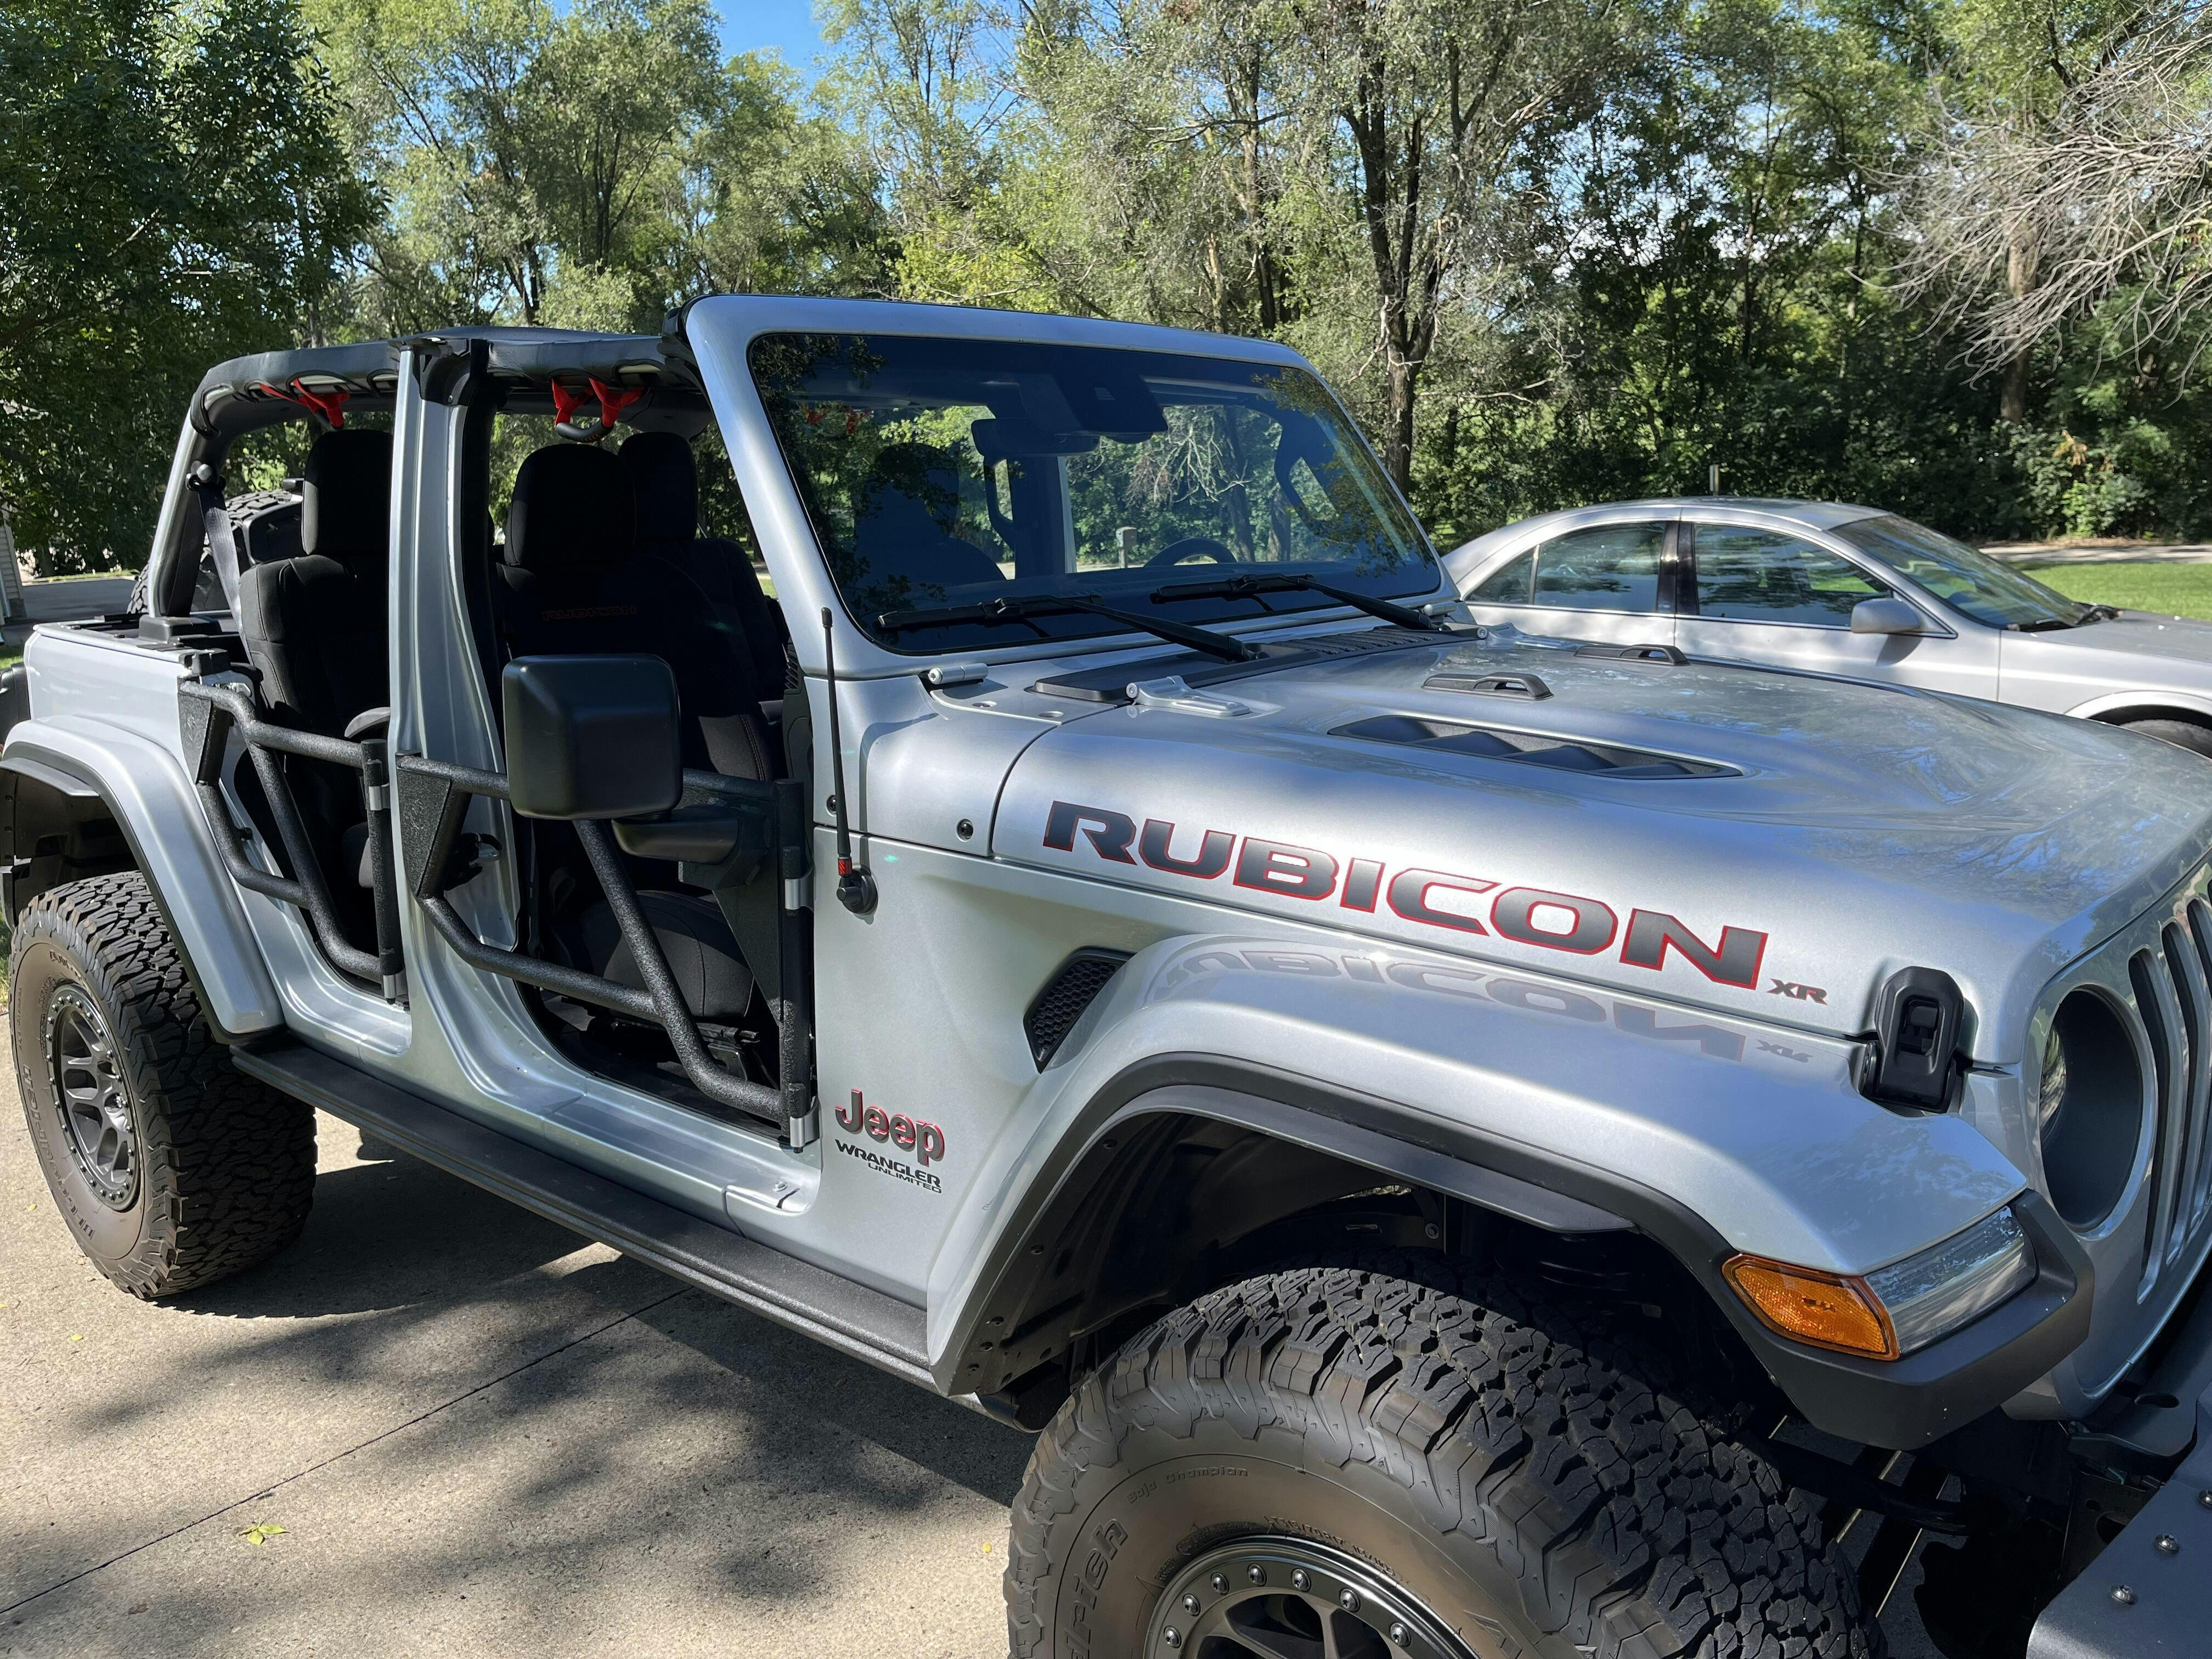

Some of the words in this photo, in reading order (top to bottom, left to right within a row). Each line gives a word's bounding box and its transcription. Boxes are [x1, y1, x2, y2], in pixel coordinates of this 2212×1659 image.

[1043, 800, 1768, 990] RUBICON
[1766, 978, 1829, 1006] XR
[835, 1088, 945, 1167] Jeep
[834, 1138, 941, 1188] WRANGLER
[868, 1162, 942, 1194] UNLIMITED
[1127, 1481, 1158, 1504] Baja
[1166, 1465, 1248, 1483] Champion
